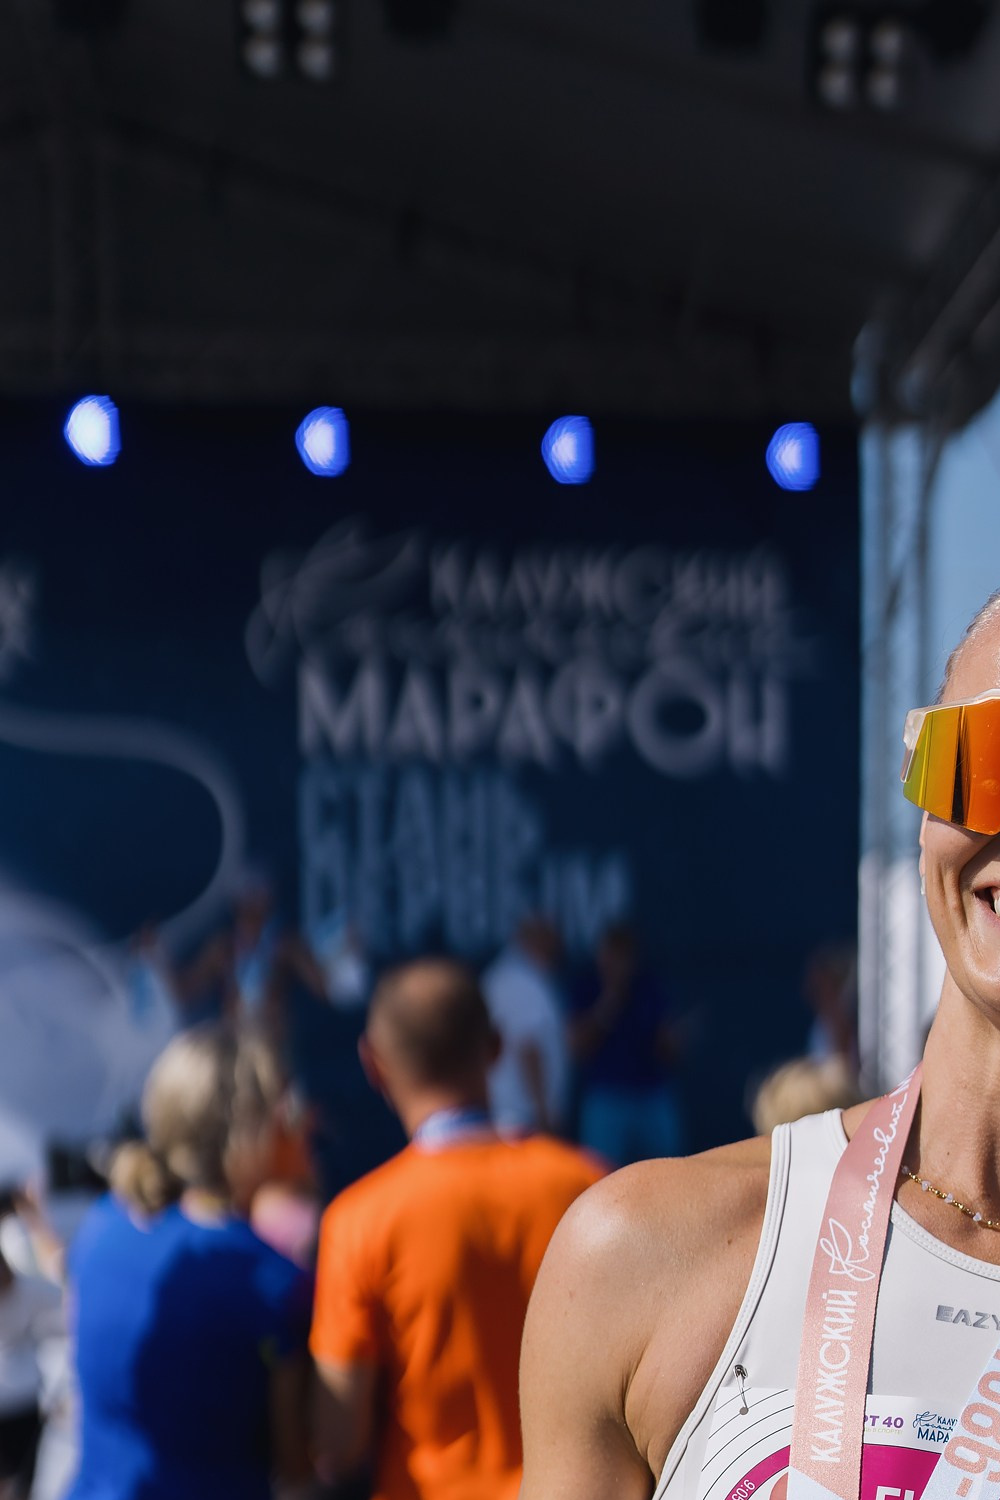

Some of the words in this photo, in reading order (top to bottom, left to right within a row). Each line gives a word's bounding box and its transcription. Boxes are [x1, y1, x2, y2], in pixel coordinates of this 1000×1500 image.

[298, 652, 790, 774] МАРАФОН
[811, 1289, 858, 1462] КАЛУЖСКИЙ
[882, 1416, 904, 1429] 40
[917, 1426, 950, 1443] МАРА
